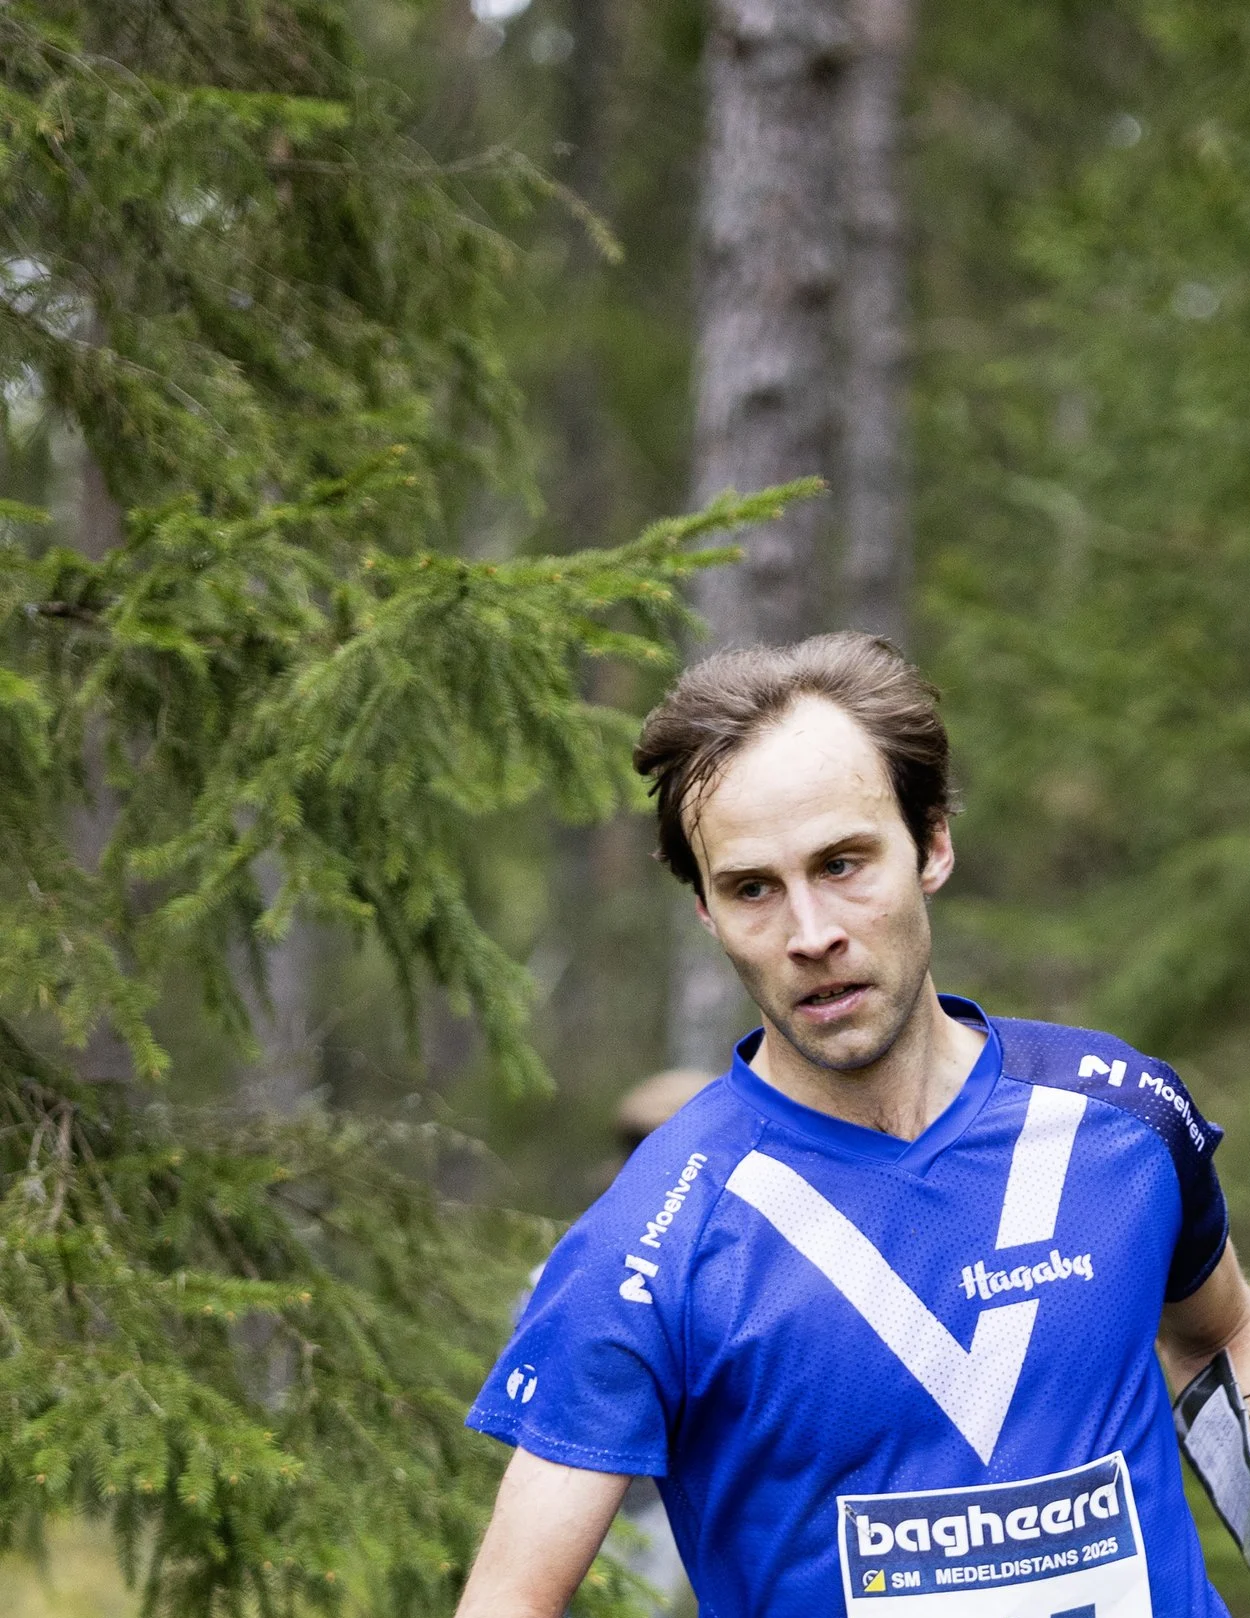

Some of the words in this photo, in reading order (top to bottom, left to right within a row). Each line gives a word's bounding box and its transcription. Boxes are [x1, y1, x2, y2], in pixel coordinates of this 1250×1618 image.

[1138, 1072, 1205, 1152] Moelven
[640, 1152, 708, 1248] Moelven
[958, 1249, 1094, 1300] Hagaby
[856, 1482, 1120, 1557] bagheera
[892, 1571, 921, 1589] SM
[936, 1550, 1078, 1585] MEDELDISTANS
[1082, 1537, 1119, 1562] 2025
